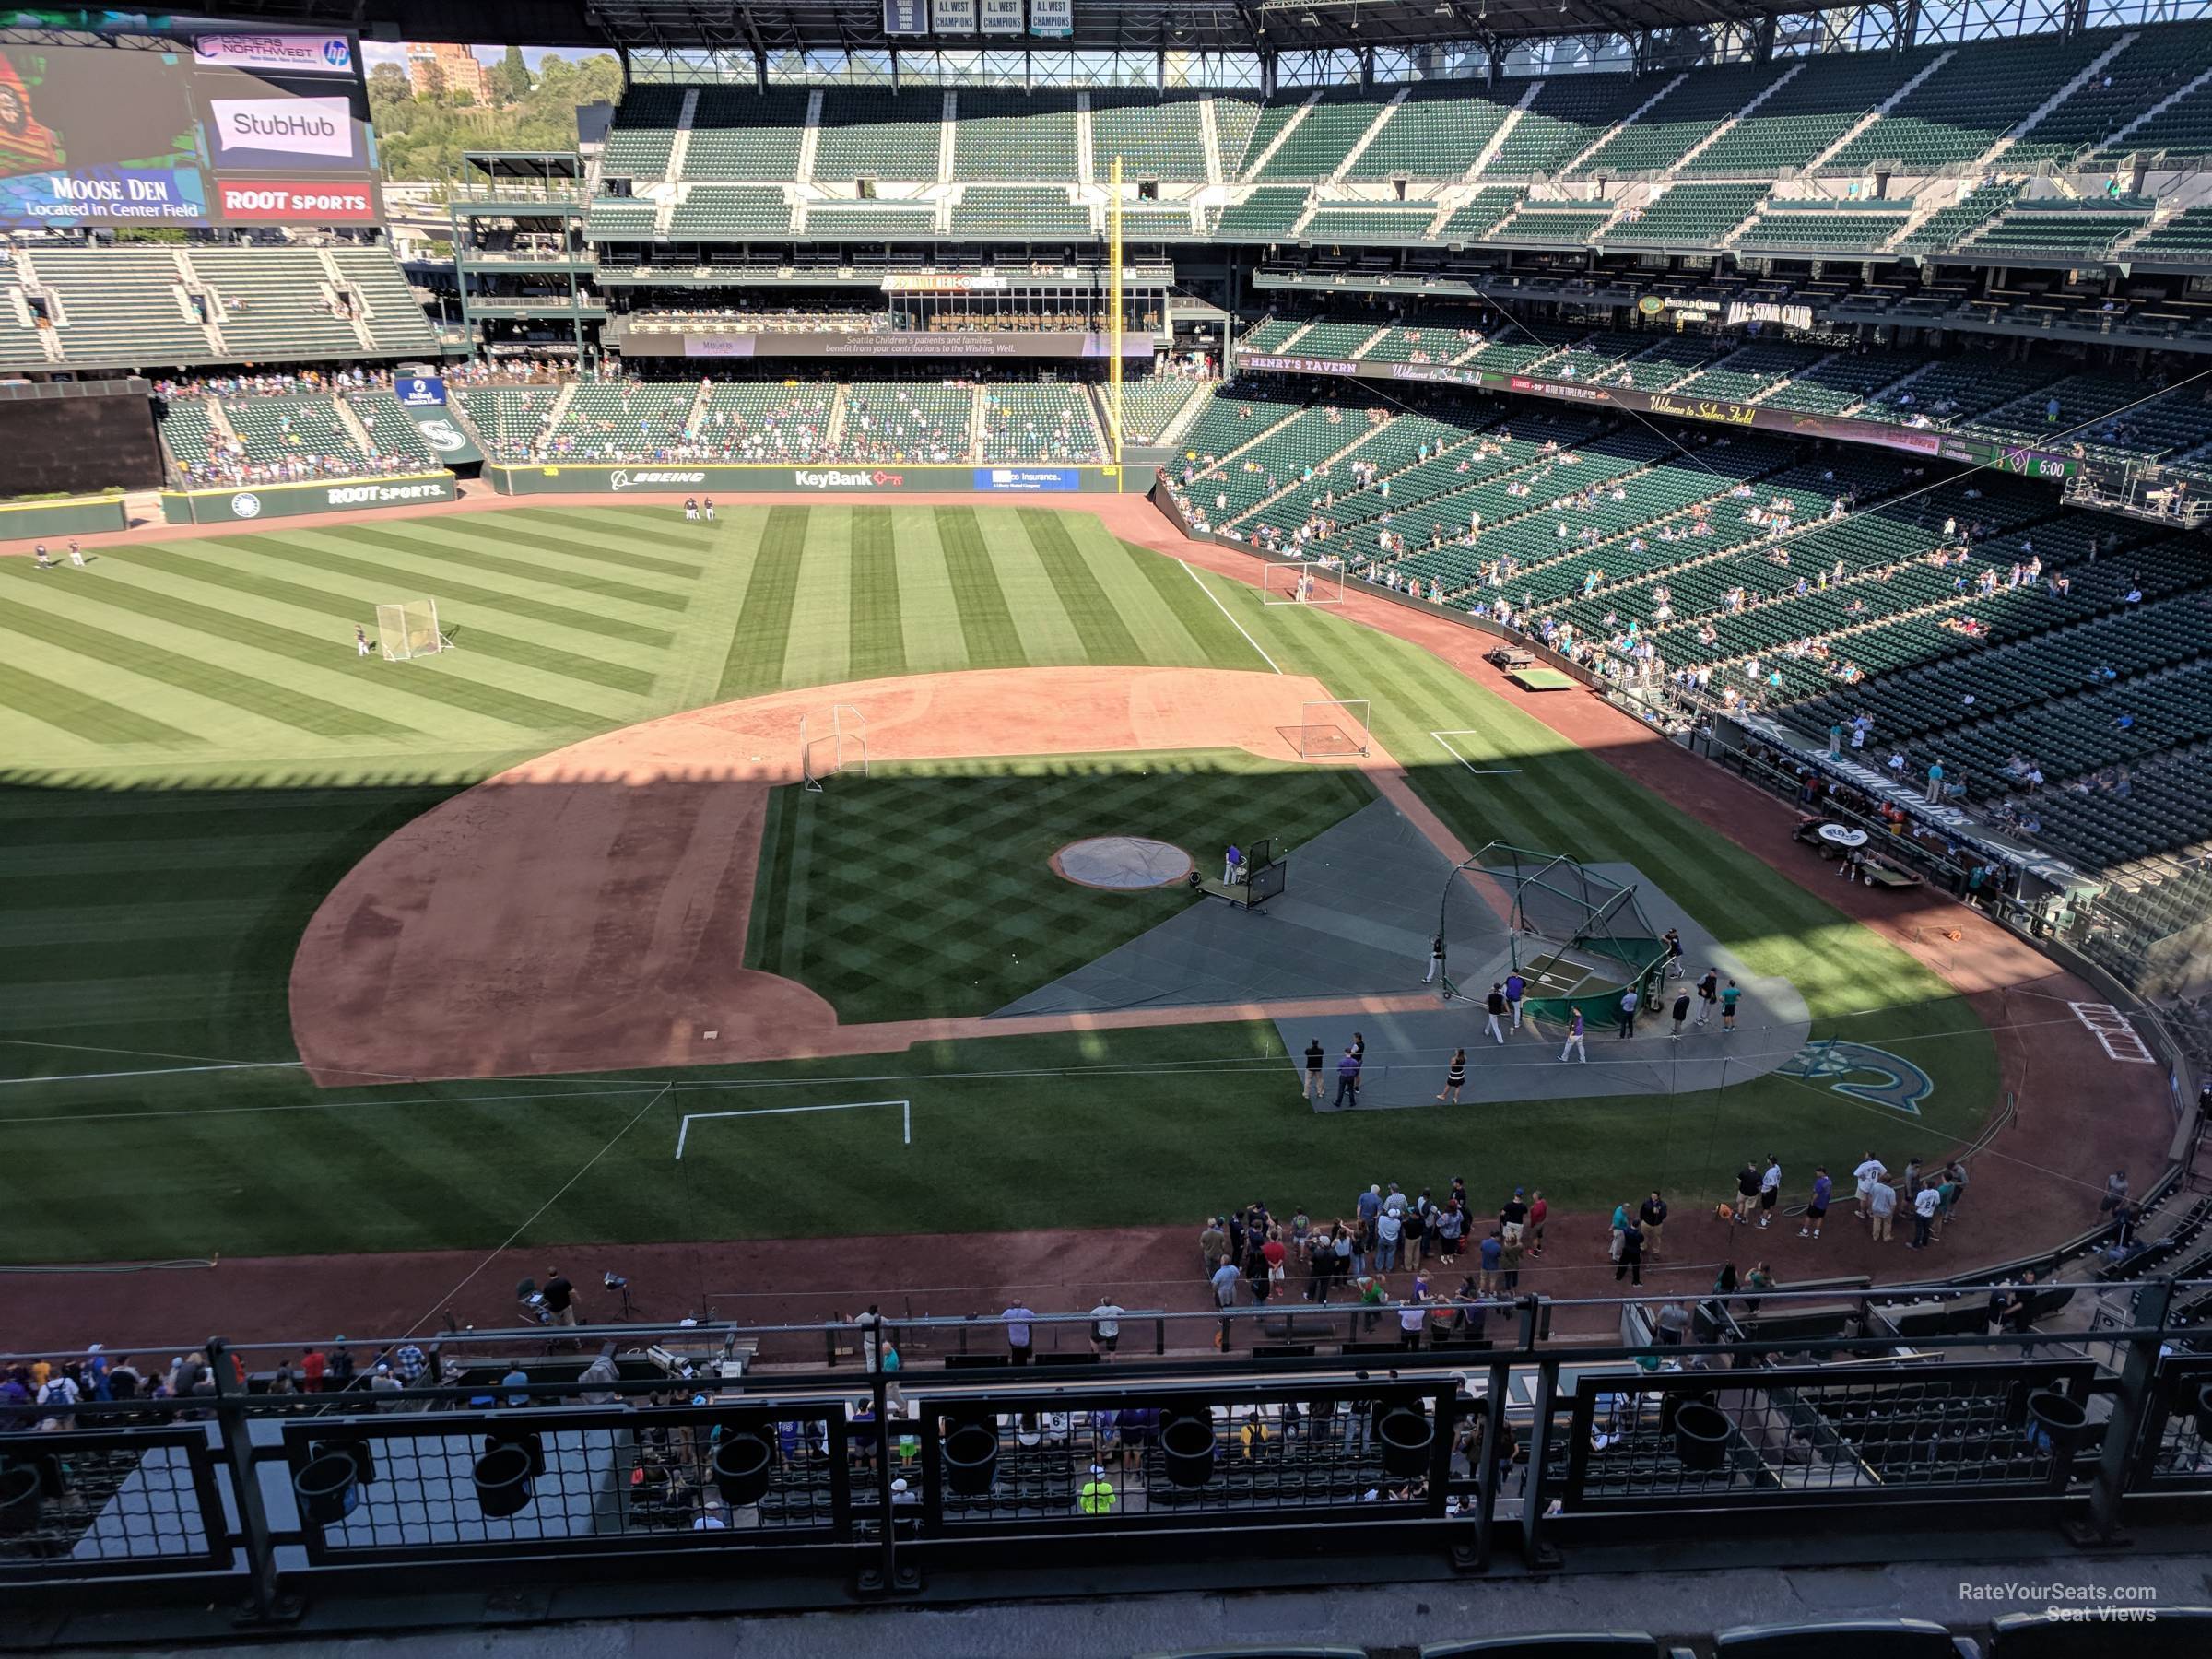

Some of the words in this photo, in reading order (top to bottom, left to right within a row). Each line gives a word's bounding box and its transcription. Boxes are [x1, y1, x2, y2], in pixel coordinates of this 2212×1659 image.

[950, 1, 969, 12] WEST
[999, 1, 1017, 12] WEST
[1048, 1, 1065, 12] WEST
[935, 16, 973, 29] CHAMPIONS
[983, 16, 1021, 29] CHAMPIONS
[1032, 15, 1070, 28] CHAMPIONS
[221, 36, 283, 46] COPIERS
[223, 44, 313, 57] NORTHWEST
[233, 112, 335, 137] StubHub
[50, 176, 124, 201] MOOSE
[129, 179, 169, 202] DEN
[225, 190, 289, 210] ROOT
[291, 195, 367, 211] SPORTS
[26, 201, 90, 217] Located
[93, 203, 107, 216] in
[111, 203, 160, 218] Center
[163, 203, 199, 218] Field
[1664, 297, 1695, 309] EMERALD
[1695, 299, 1721, 311] QUEEN
[1781, 305, 1813, 330] CLUB
[846, 335, 874, 345] Seattle
[876, 335, 914, 345] Children's
[915, 336, 945, 347] patients
[947, 335, 960, 345] and
[961, 335, 993, 345] families
[826, 345, 852, 353] benefit
[853, 345, 872, 353] from
[873, 347, 890, 355] your
[891, 345, 941, 353] contributions
[951, 345, 963, 353] the
[965, 345, 994, 355] Wishing
[996, 345, 1016, 353] Well.
[1250, 357, 1301, 370] HENRY'S
[1305, 360, 1357, 374] TAVERN
[1392, 364, 1429, 380] Welcome
[1430, 370, 1438, 380] to
[1439, 368, 1464, 382] Safeco
[1464, 371, 1483, 385] Field
[1650, 395, 1685, 416] Welcome
[1686, 405, 1694, 416] to
[1695, 402, 1725, 421] Safeco
[1726, 406, 1756, 425] Field
[2039, 462, 2065, 477] 6:00
[634, 472, 705, 483] BOEING
[795, 470, 872, 488] KeyBank
[327, 486, 380, 504] ROOT
[380, 484, 442, 500] SPORTS
[1053, 1416, 1060, 1427] 6
